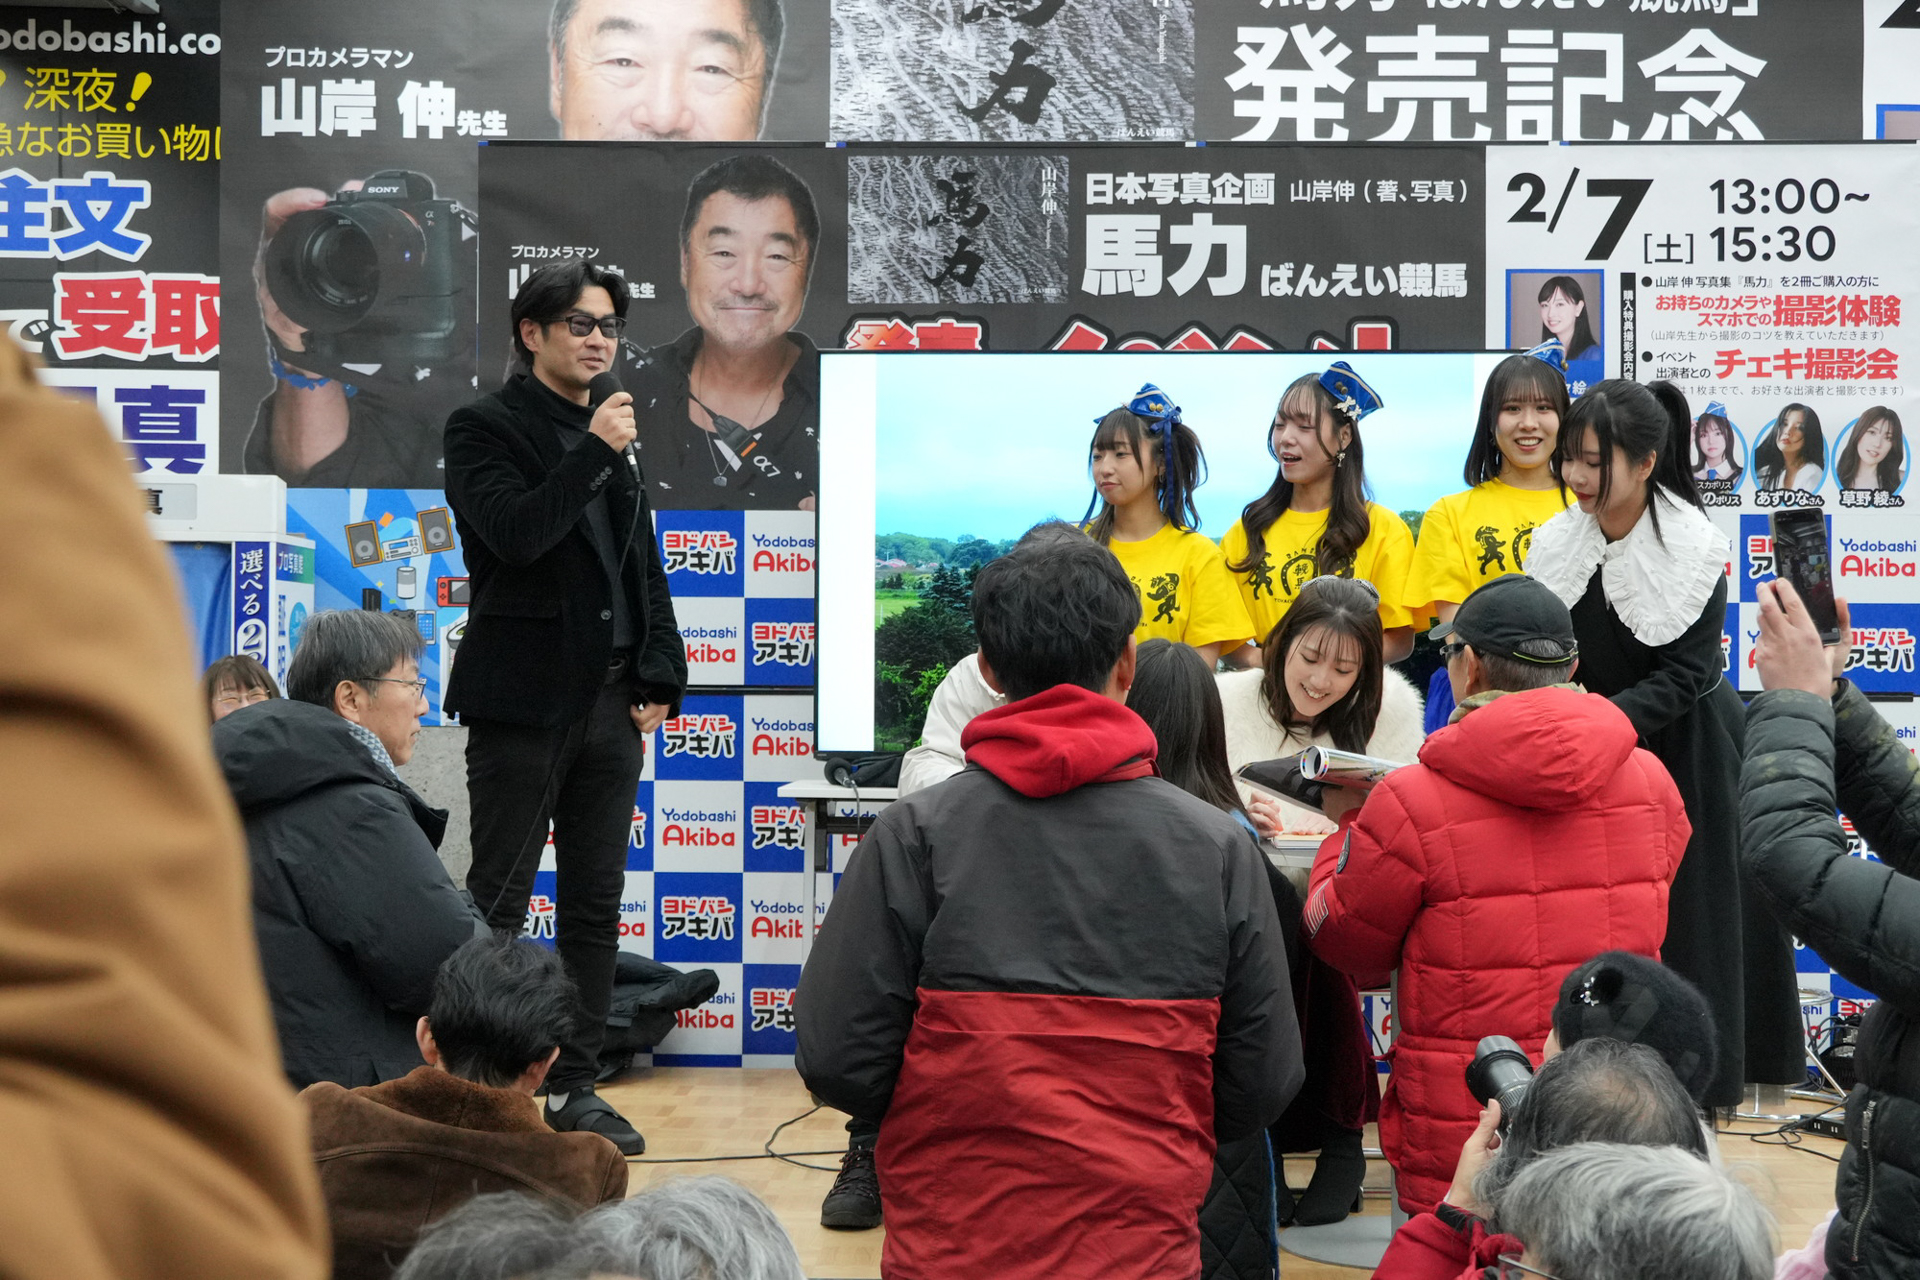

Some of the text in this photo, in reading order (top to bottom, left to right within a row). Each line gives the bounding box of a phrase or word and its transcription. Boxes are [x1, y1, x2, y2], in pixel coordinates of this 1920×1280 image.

[265, 46, 414, 69] プロカメラマン
[24, 66, 152, 113] 深夜!
[1223, 23, 1768, 141] 発売記念
[261, 78, 376, 137] 山岸
[367, 186, 400, 194] SONY
[1086, 172, 1275, 205] 日本写真企画
[1506, 166, 1654, 261] 2/7
[511, 244, 600, 259] プロカメラマン
[1643, 233, 1694, 264] [土]
[1709, 225, 1836, 262] 15:30
[1081, 212, 1247, 297] 馬力
[1260, 262, 1468, 298] ばんえい競馬
[1655, 275, 1678, 289] 山岸
[1655, 294, 1772, 311] お持ちのカメラや
[1773, 294, 1902, 327] 撮影体験
[1697, 312, 1772, 328] スマホでの
[1656, 352, 1697, 363] イベント
[1714, 347, 1899, 381] チェキ撮影会
[1656, 367, 1711, 379] 出演者との
[1700, 490, 1741, 506] のポリス
[1756, 490, 1823, 506] あずりなさん
[1841, 490, 1871, 506] 草野
[664, 532, 736, 549] ヨドバシ
[1839, 538, 1917, 553] Yodobashi
[666, 551, 735, 572] アキバ
[752, 550, 815, 572] Akib
[1840, 554, 1916, 577] Akiba
[663, 716, 735, 732] ヨドバシ
[664, 734, 735, 757] アキバ
[752, 734, 814, 756] Akib
[661, 808, 736, 823] Yodobashi
[662, 824, 735, 847] Akiba
[754, 827, 805, 848] アキ
[663, 899, 734, 914] ヨドバシ
[664, 916, 733, 938] アキバ
